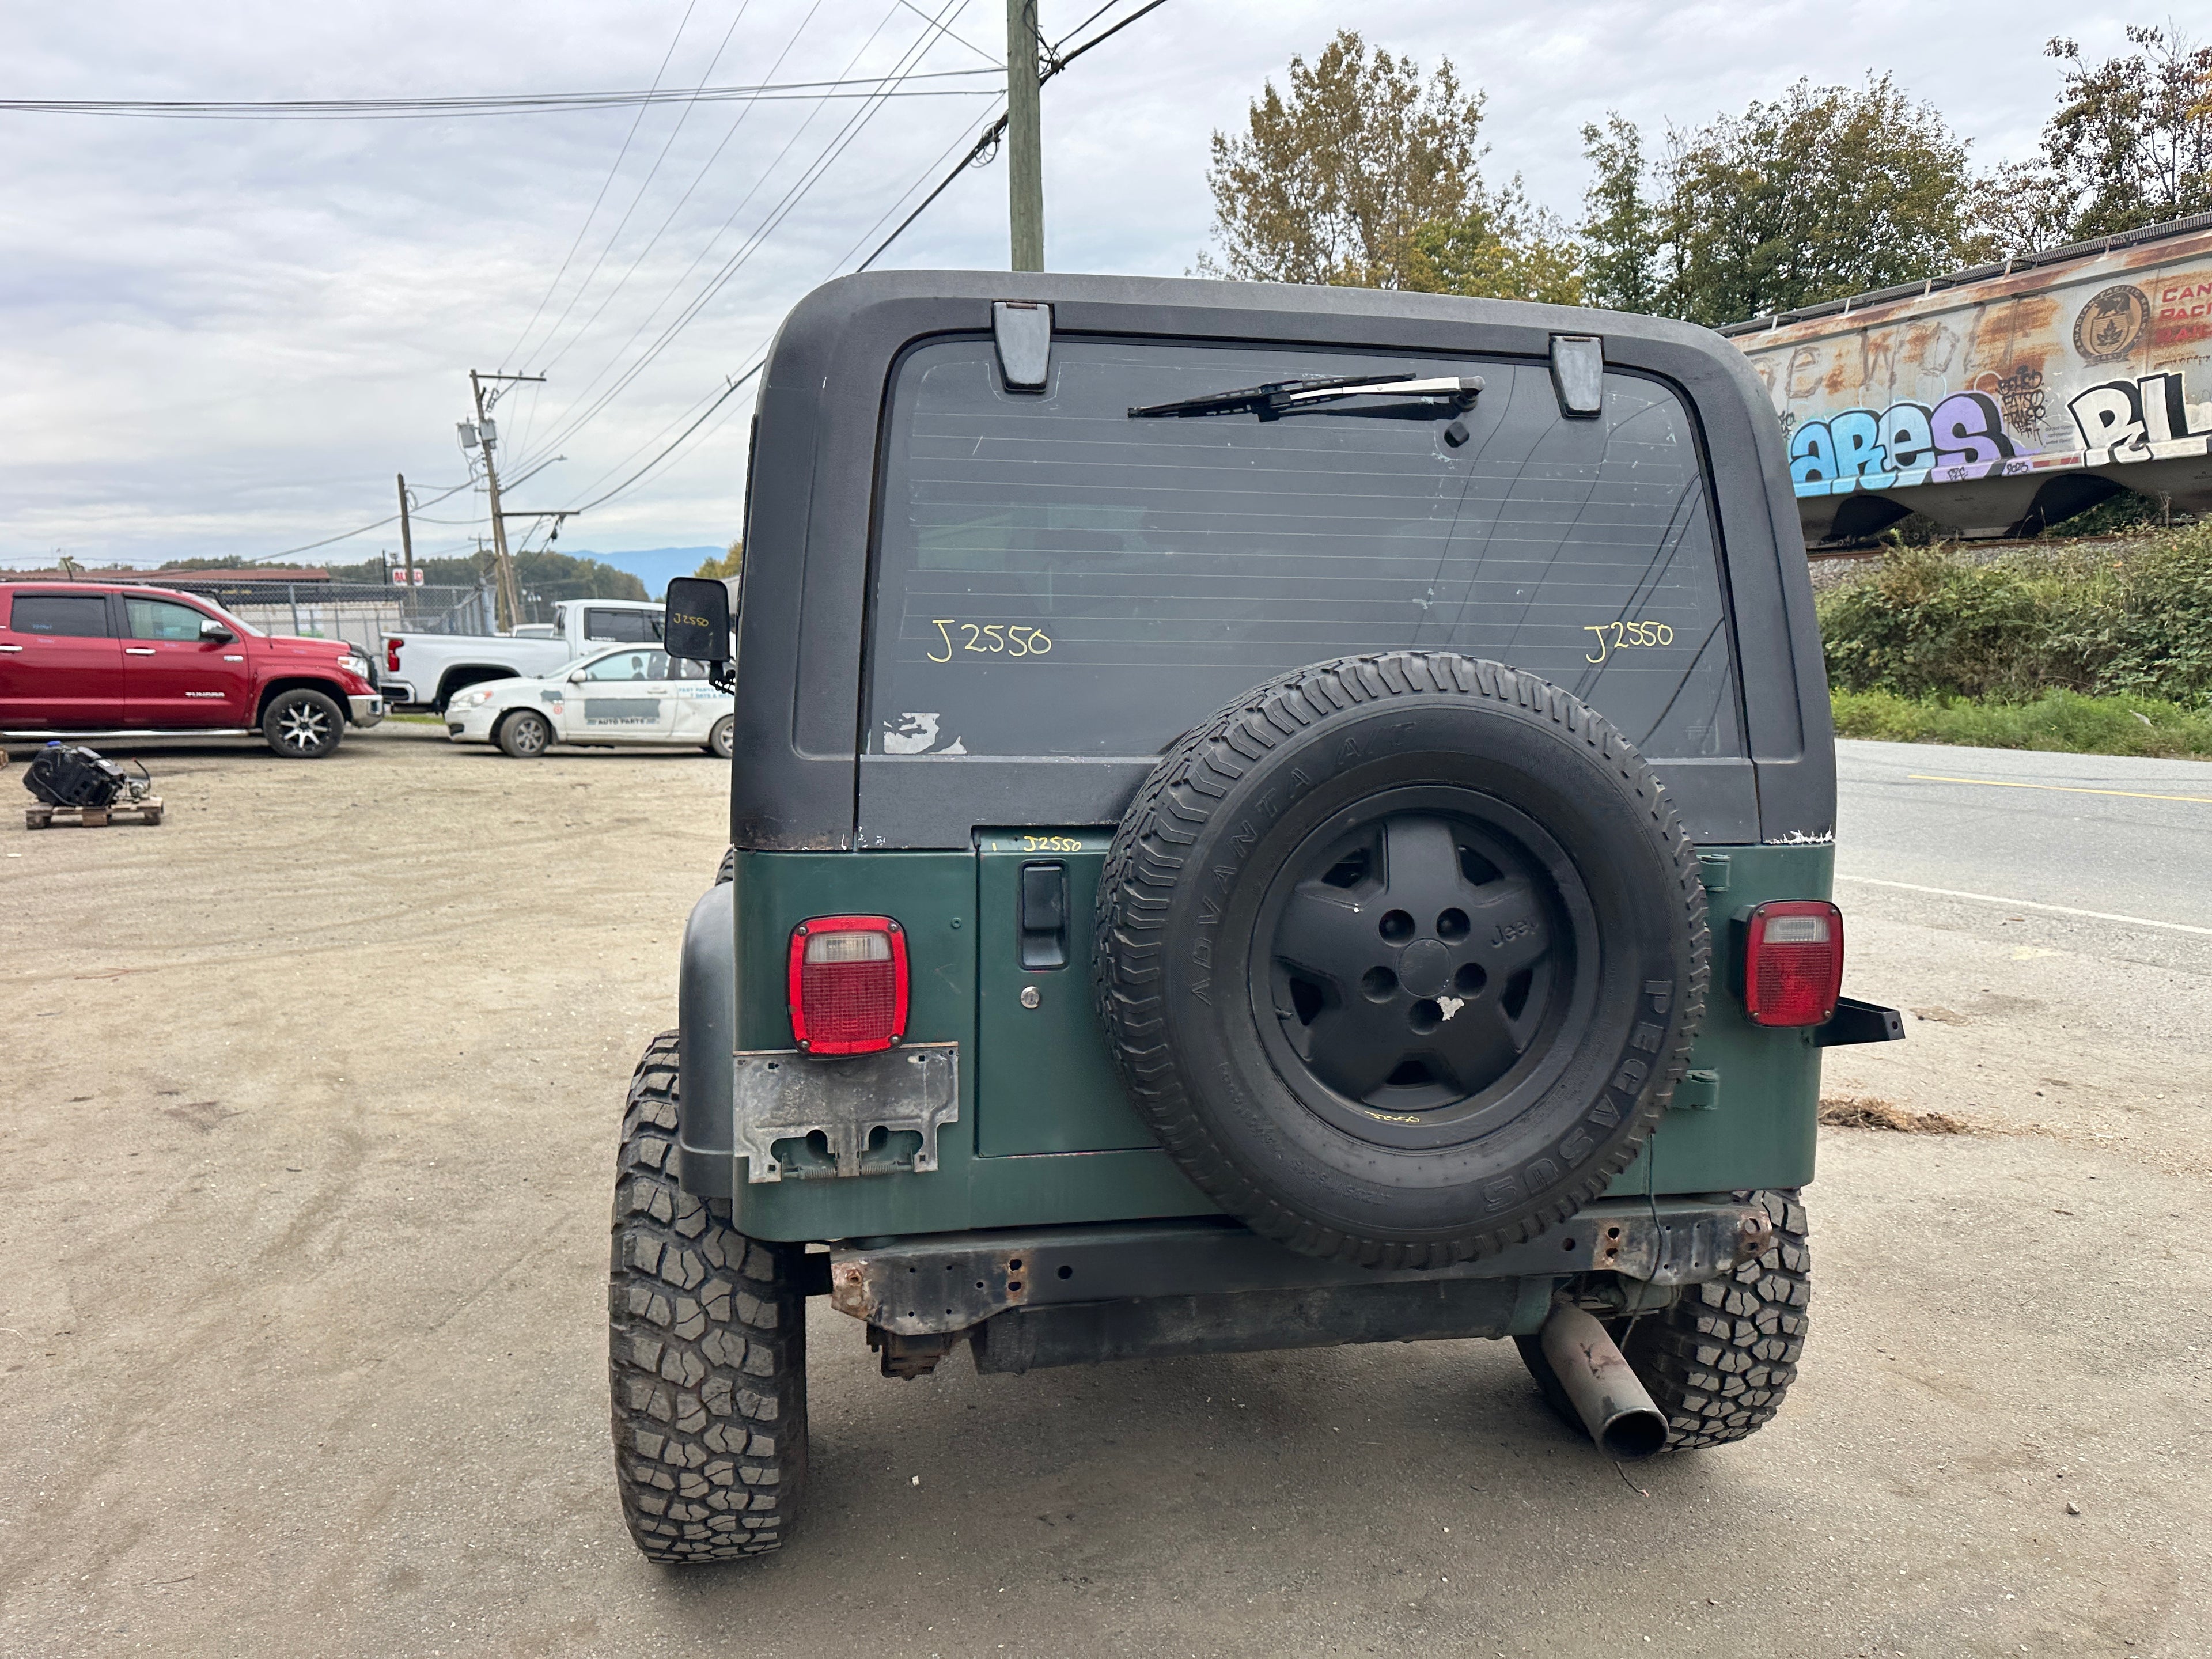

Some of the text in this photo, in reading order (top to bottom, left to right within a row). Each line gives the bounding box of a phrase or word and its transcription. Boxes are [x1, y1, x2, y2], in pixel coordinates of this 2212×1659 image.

[673, 613, 709, 627] J2550
[927, 619, 1052, 662] J2550
[1584, 620, 1673, 663] J2550
[1023, 836, 1082, 851] J2550
[1480, 979, 1673, 1213] PEGASUS
